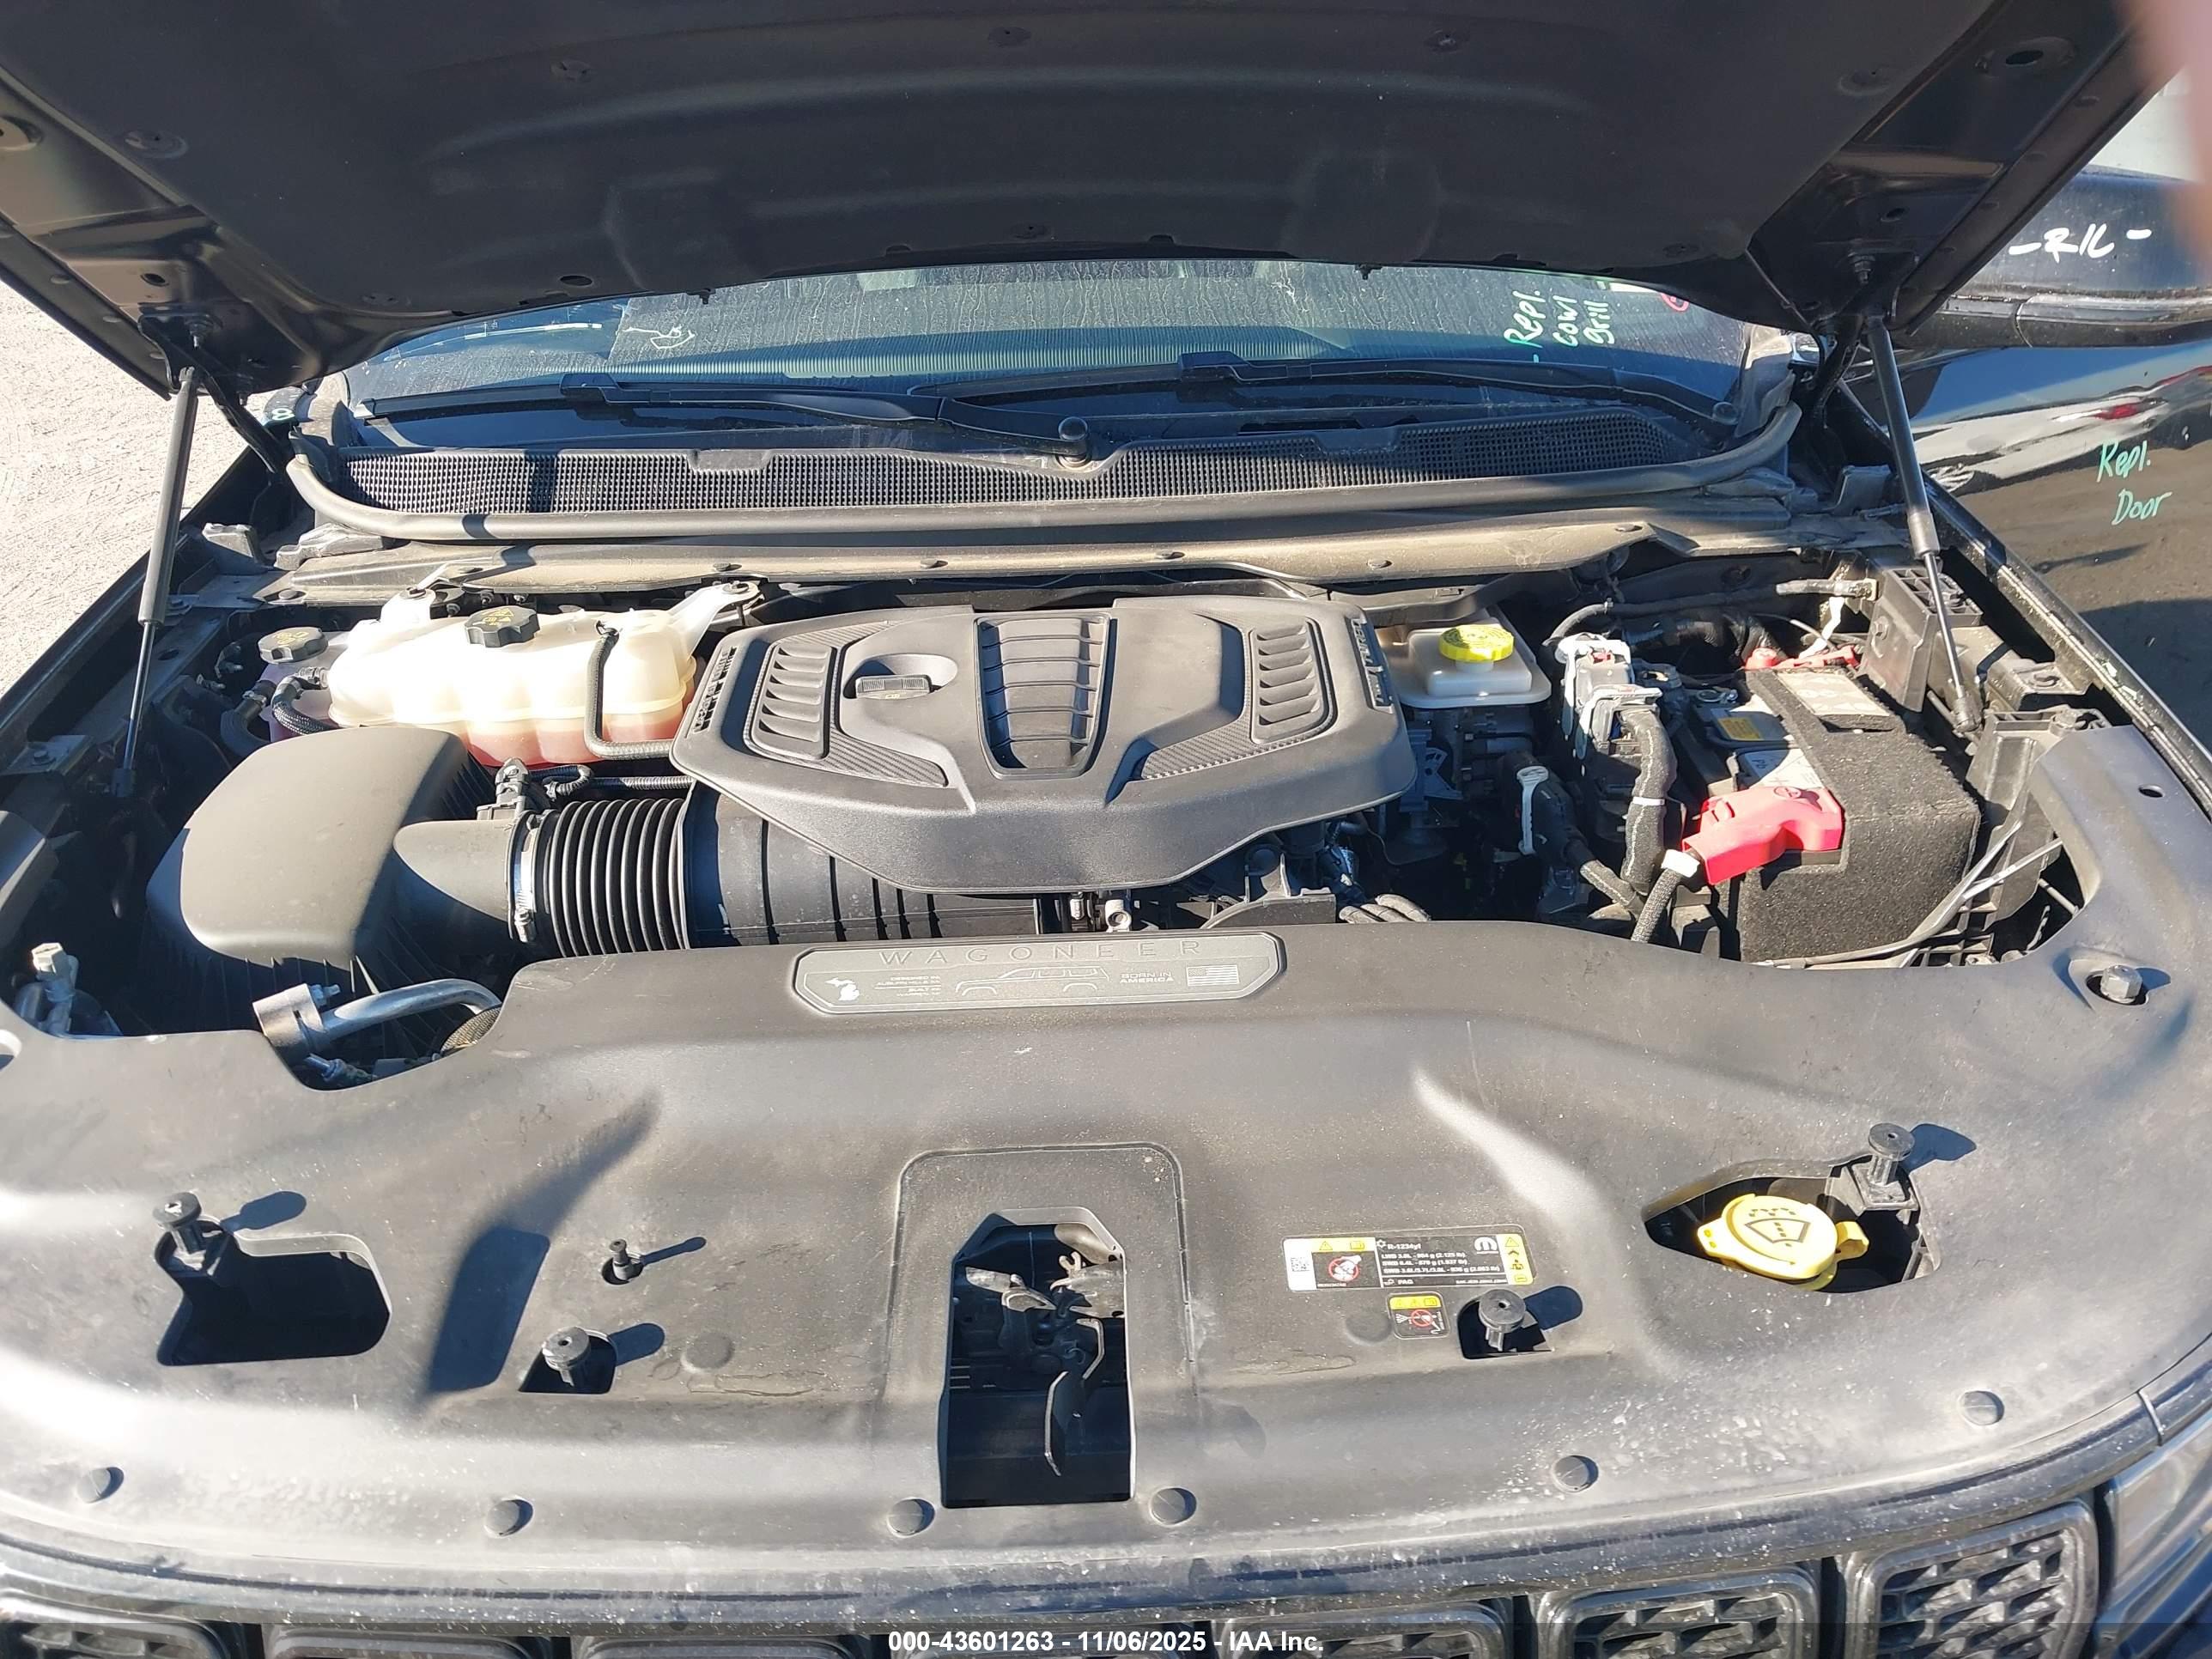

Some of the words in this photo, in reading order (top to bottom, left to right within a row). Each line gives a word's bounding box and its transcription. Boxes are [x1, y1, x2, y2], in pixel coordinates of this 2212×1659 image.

[2096, 439, 2151, 483] Repl.
[2112, 488, 2172, 526] Door
[878, 940, 1200, 965] WAGONEER
